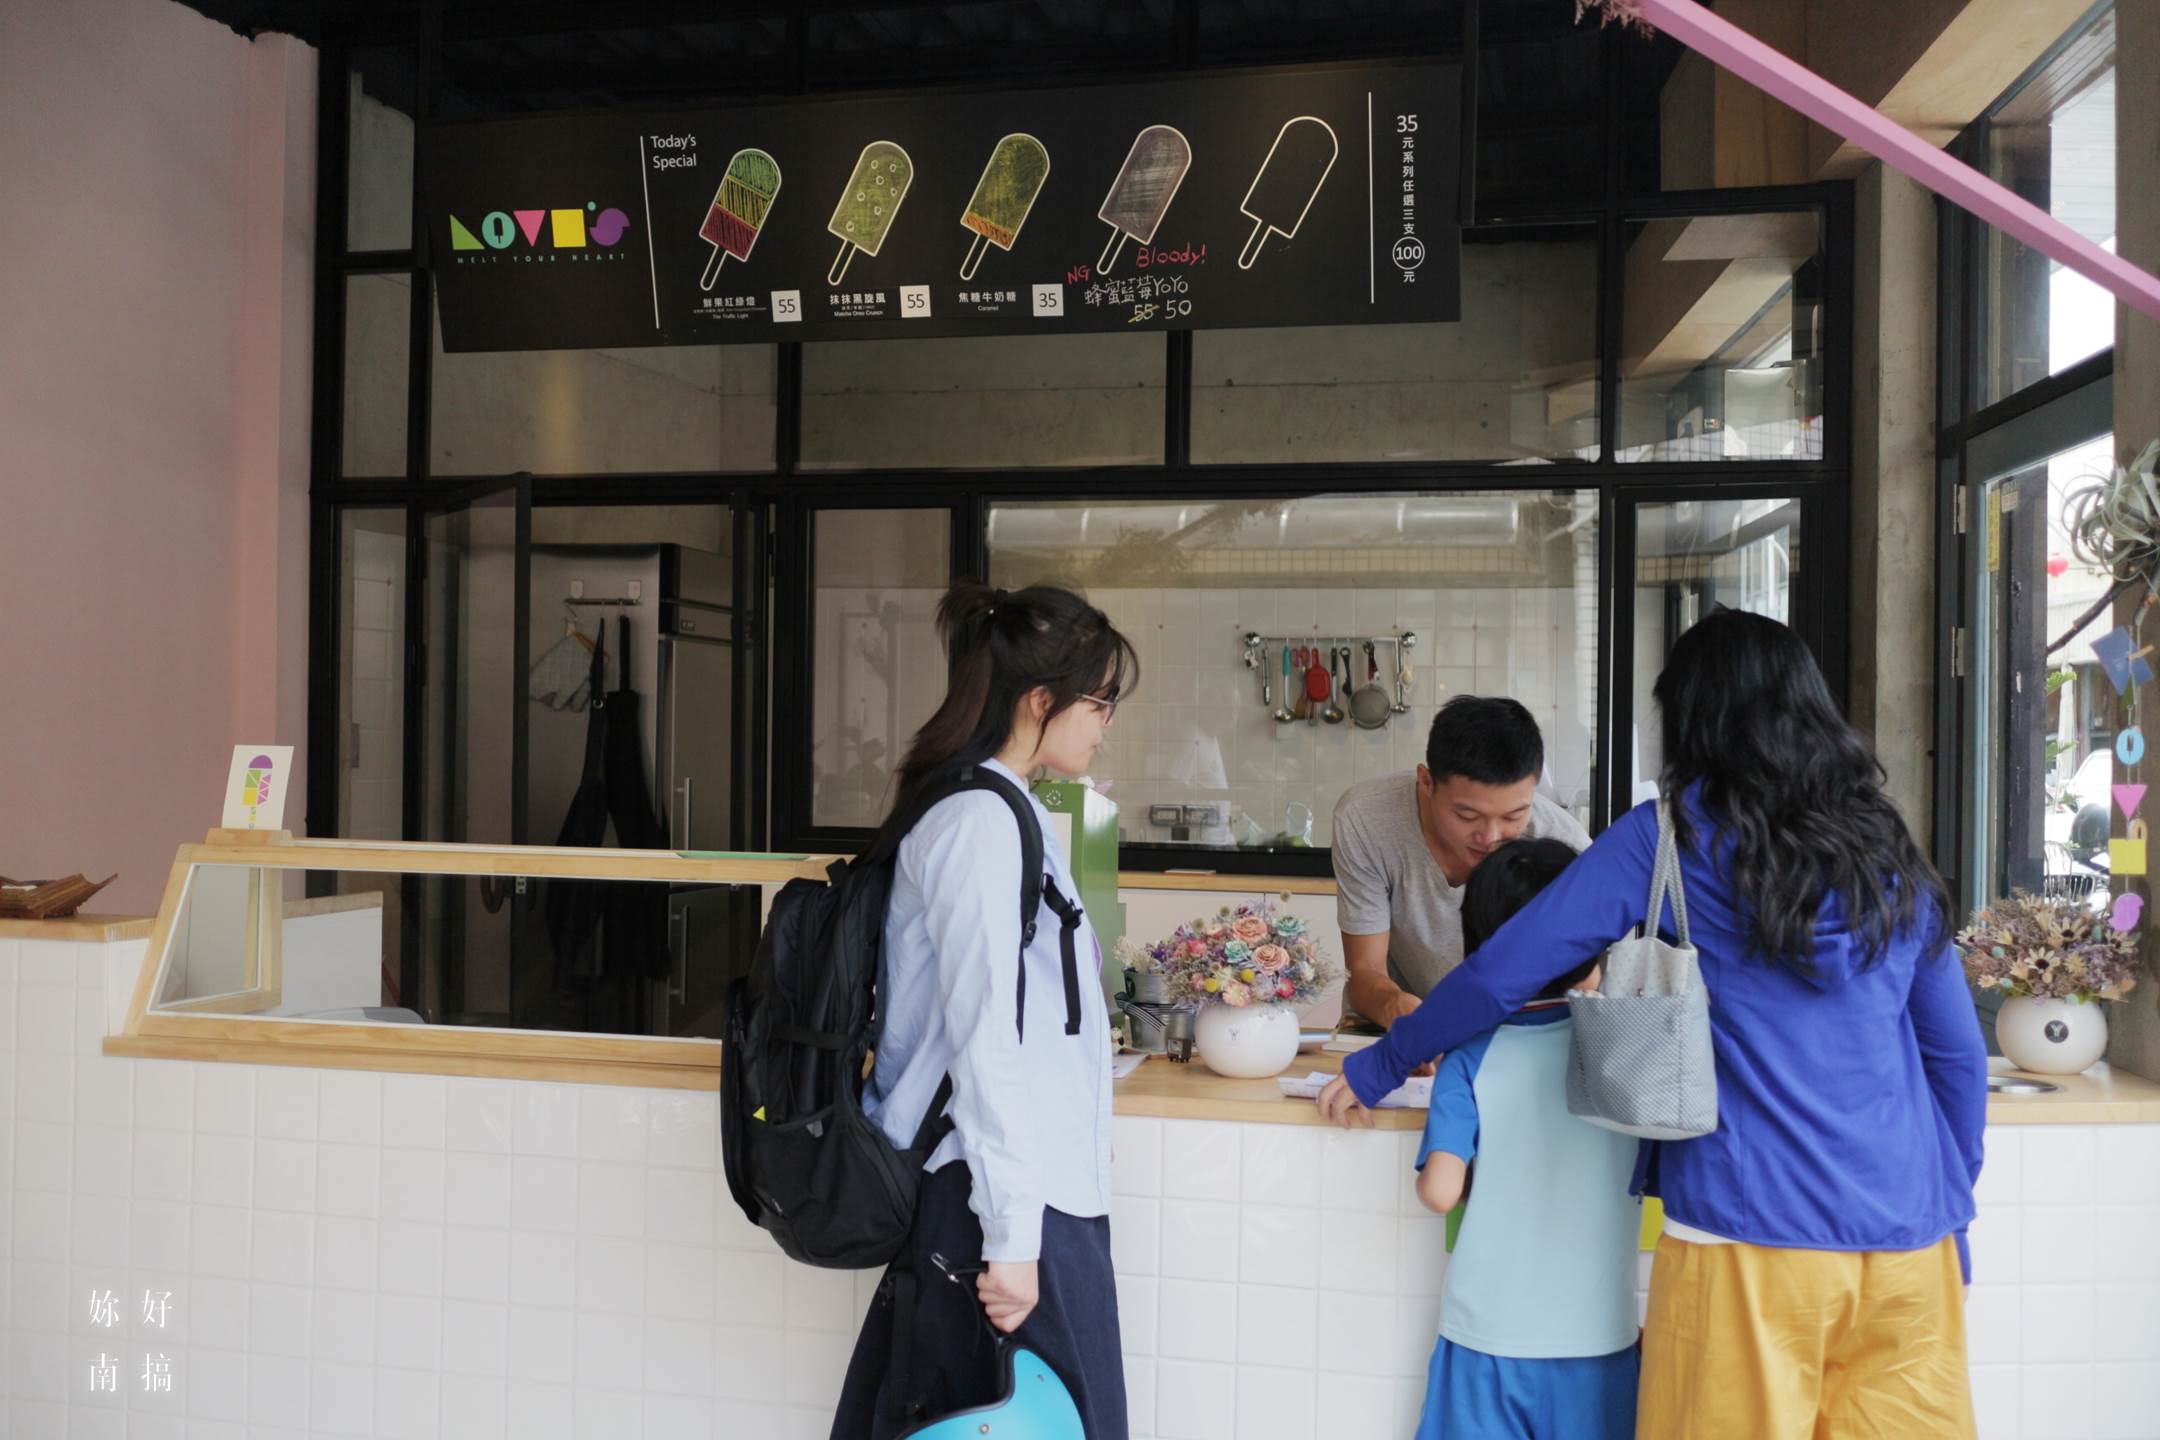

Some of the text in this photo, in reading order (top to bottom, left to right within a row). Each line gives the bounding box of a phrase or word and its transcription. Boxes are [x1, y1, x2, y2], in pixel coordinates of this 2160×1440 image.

[650, 133, 697, 150] Today's
[652, 152, 697, 171] Special
[457, 253, 625, 264] MELT YOUR HEART
[1136, 241, 1208, 269] Bloody!
[1066, 263, 1091, 285] NG
[829, 292, 886, 305] 抹抹黑旋風
[907, 293, 925, 309] 55
[958, 290, 1017, 303] 焦糖牛奶糖
[1039, 292, 1057, 308] 35
[778, 298, 796, 314] 55
[1164, 299, 1192, 320] 50
